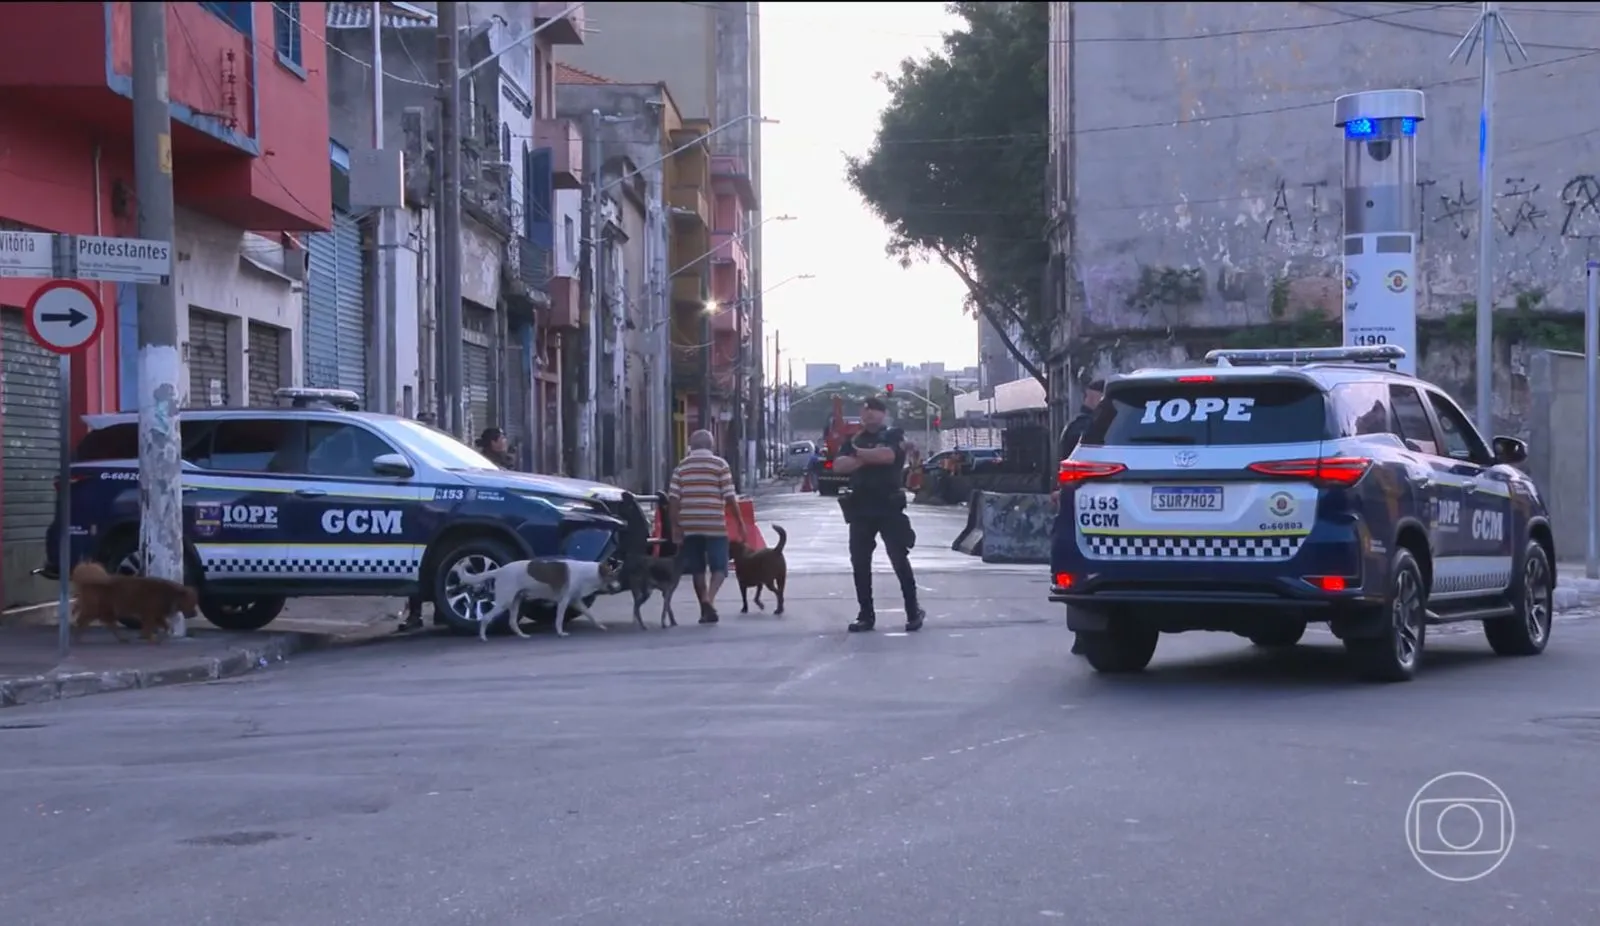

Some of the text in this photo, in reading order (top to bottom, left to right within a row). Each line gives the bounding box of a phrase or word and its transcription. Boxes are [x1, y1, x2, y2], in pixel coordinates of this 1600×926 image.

[79, 239, 168, 260] Protestantes
[1140, 397, 1255, 424] IOPE
[442, 489, 464, 500] 153
[1089, 496, 1119, 510] 153
[1158, 494, 1215, 508] SUR7H02
[222, 504, 278, 523] IOPE
[321, 509, 403, 535] GCM
[1080, 513, 1120, 528] GCM
[1471, 508, 1504, 541] GCM
